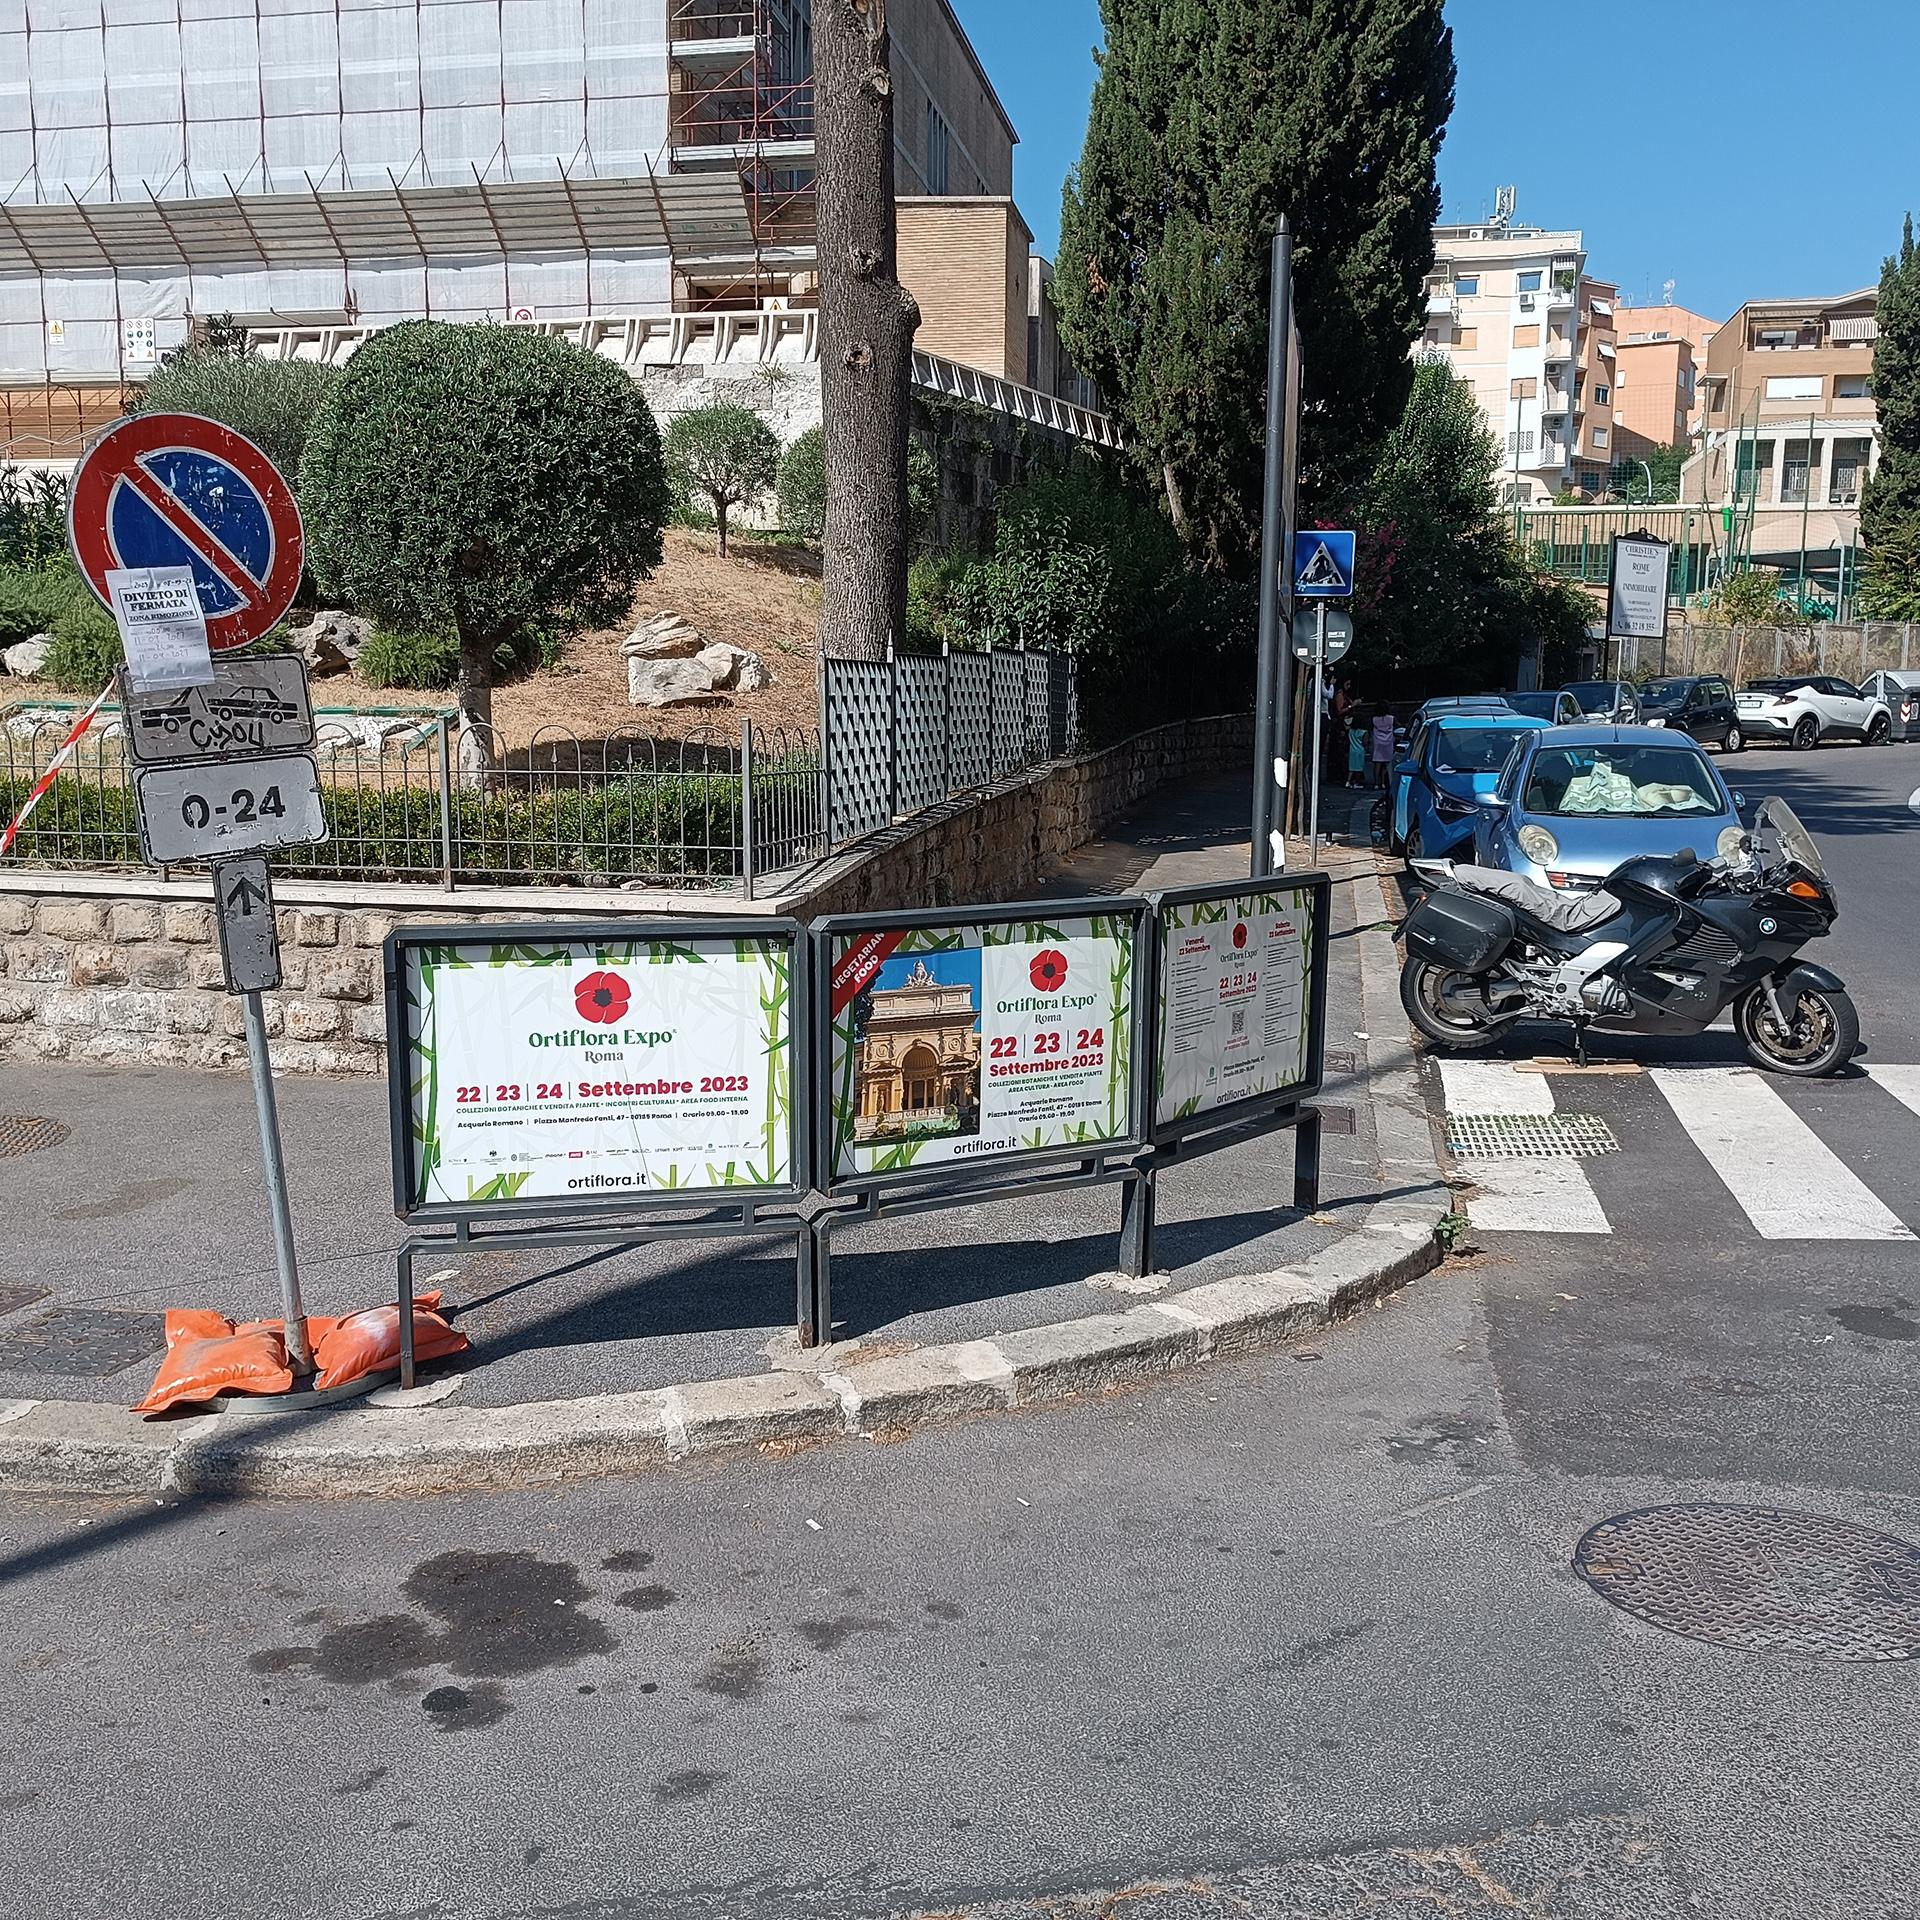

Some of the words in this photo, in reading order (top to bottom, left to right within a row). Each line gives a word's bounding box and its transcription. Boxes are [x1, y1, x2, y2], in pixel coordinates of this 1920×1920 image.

[123, 590, 173, 602] DIVIETO
[176, 589, 188, 598] DI
[130, 600, 186, 611] FERMATA
[128, 614, 150, 622] ZONA
[182, 786, 286, 829] 0-24
[832, 932, 885, 990] VEGETARIAN
[854, 955, 878, 983] FOOD
[1220, 977, 1228, 989] 22
[1234, 974, 1243, 986] 23
[1248, 972, 1257, 983] 24
[997, 997, 1058, 1013] Ortiflora
[1035, 1014, 1062, 1024] Roma
[528, 1030, 618, 1048] Ortiflora
[990, 1036, 1017, 1058] 22
[1034, 1032, 1060, 1054] 23
[1077, 1028, 1104, 1050] 24
[585, 1051, 624, 1064] Roma
[990, 1058, 1069, 1077] Settembre
[1072, 1053, 1104, 1068] 2023
[456, 1086, 481, 1103] 22
[496, 1084, 521, 1101] 23
[536, 1083, 563, 1099] 24
[578, 1079, 693, 1097] Settembre
[700, 1075, 749, 1092] 2023
[988, 1079, 1021, 1088] COLLEZIONI
[1217, 1084, 1251, 1104] ortiflora.it
[1020, 1098, 1048, 1107] Acquario
[1008, 1108, 1038, 1116] Manfredo
[458, 1120, 491, 1129] Acquario
[954, 1136, 1016, 1154] ortiflora.it
[568, 1172, 646, 1188] ortiflora.it
